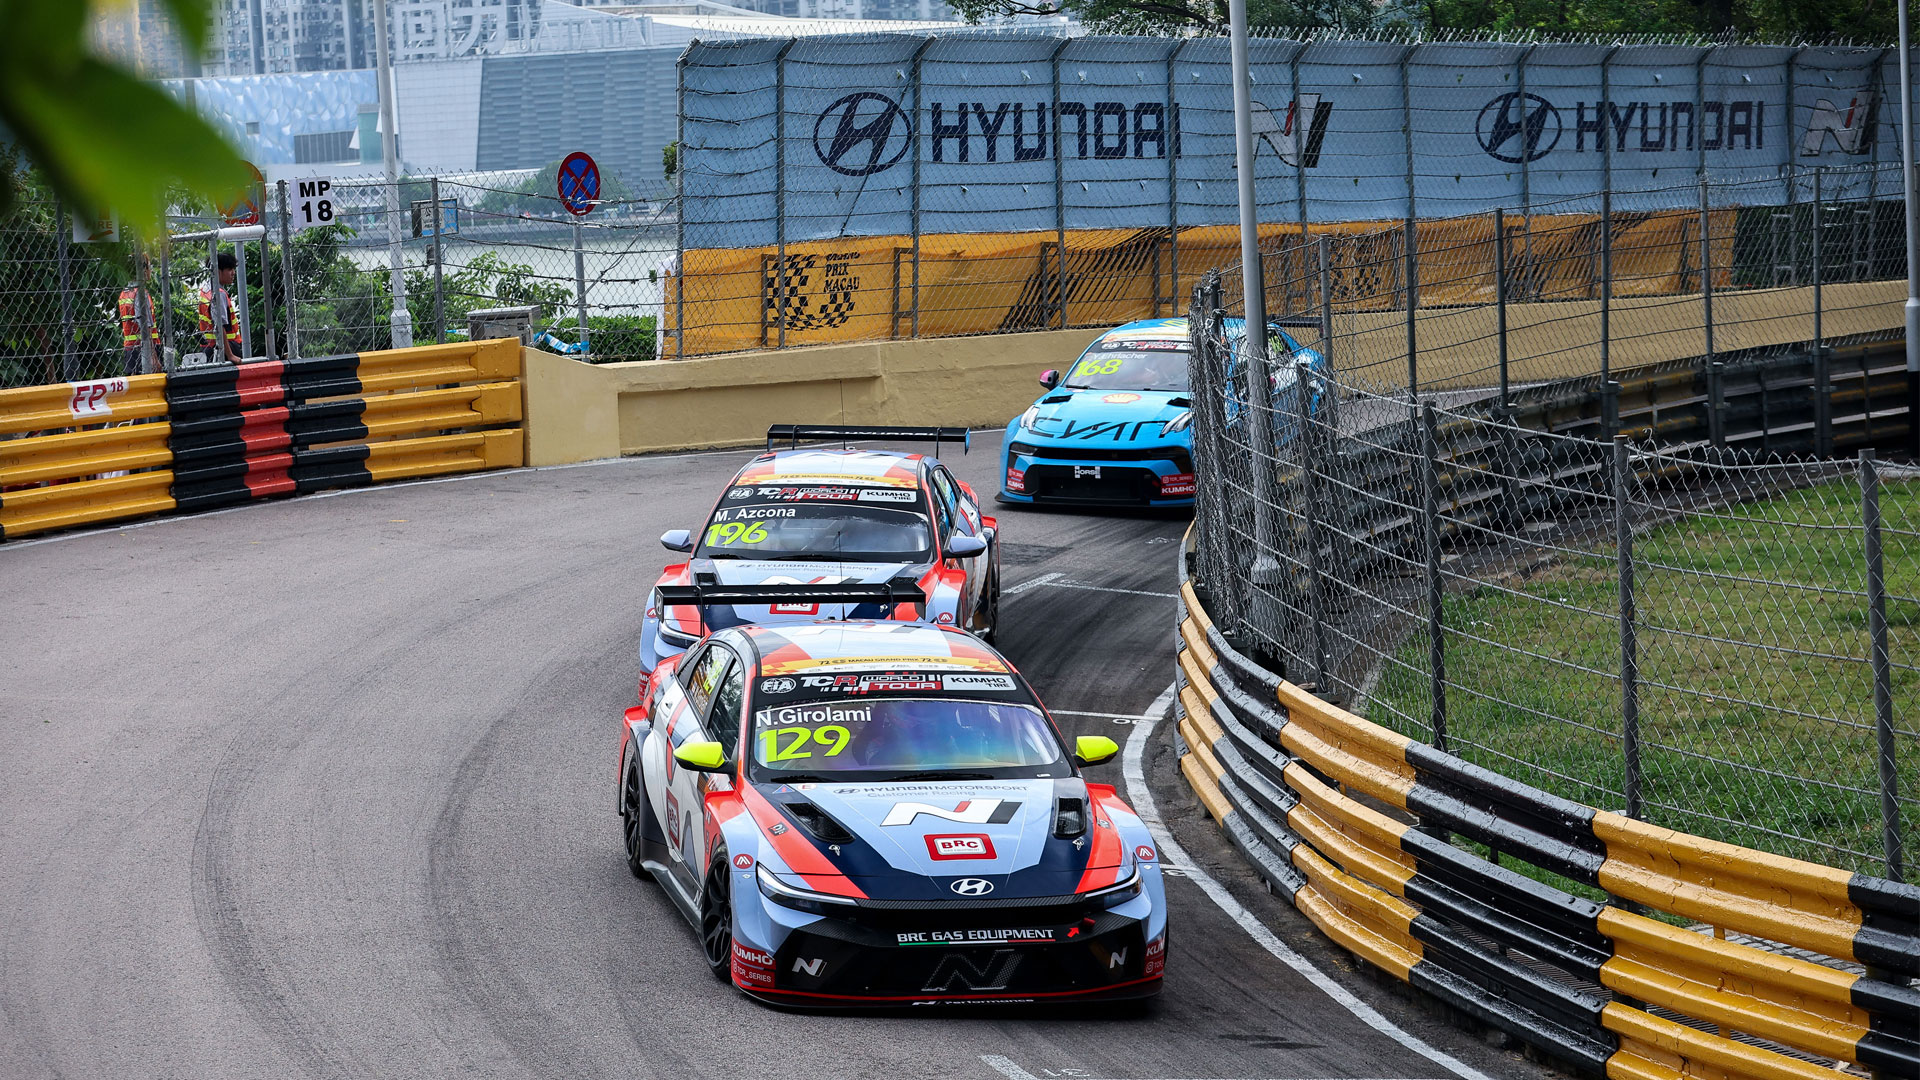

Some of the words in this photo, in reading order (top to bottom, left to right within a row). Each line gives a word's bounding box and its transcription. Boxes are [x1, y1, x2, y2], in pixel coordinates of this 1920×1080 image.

[931, 102, 1181, 161] HYUNDAI
[1576, 101, 1763, 152] HYUNDAI
[299, 180, 331, 198] MP
[302, 199, 333, 223] 18
[825, 263, 849, 277] PRIX
[824, 277, 860, 292] MACAU
[1074, 359, 1122, 378] 168
[111, 380, 124, 393] 18
[73, 384, 107, 412] FP
[758, 487, 798, 496] TCR
[714, 511, 731, 522] M.
[736, 507, 796, 519] Azcona
[706, 521, 768, 547] 196
[800, 675, 858, 687] TCR
[875, 682, 937, 690] TOUR
[756, 707, 871, 727] N.Girolami
[759, 725, 851, 763] 129
[941, 839, 978, 849] BRC
[897, 933, 926, 943] BRC
[932, 931, 964, 941] GAS
[968, 929, 1054, 940] EQUIPMENT
[733, 942, 773, 965] KUMHO
[737, 965, 771, 982] TCR_SERIES
